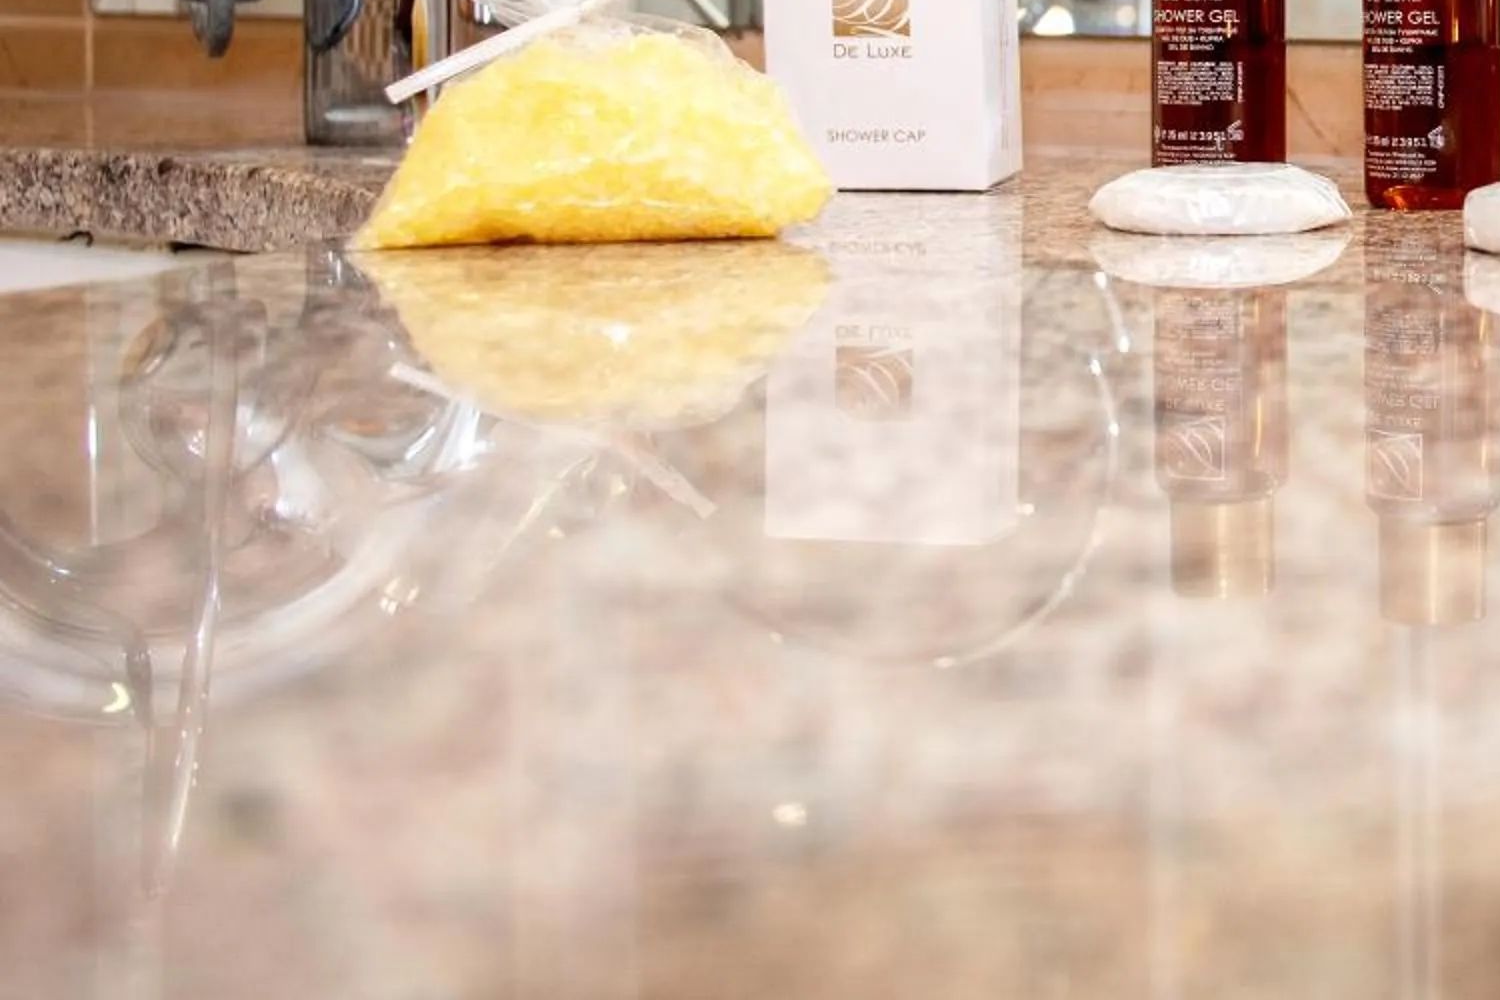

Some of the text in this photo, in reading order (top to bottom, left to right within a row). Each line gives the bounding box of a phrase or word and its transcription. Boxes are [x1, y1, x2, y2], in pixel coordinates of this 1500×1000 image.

[1208, 9, 1240, 23] GEL
[1407, 10, 1441, 25] GEL
[833, 42, 913, 59] DE LUXE
[827, 129, 926, 143] SHOWER CAP
